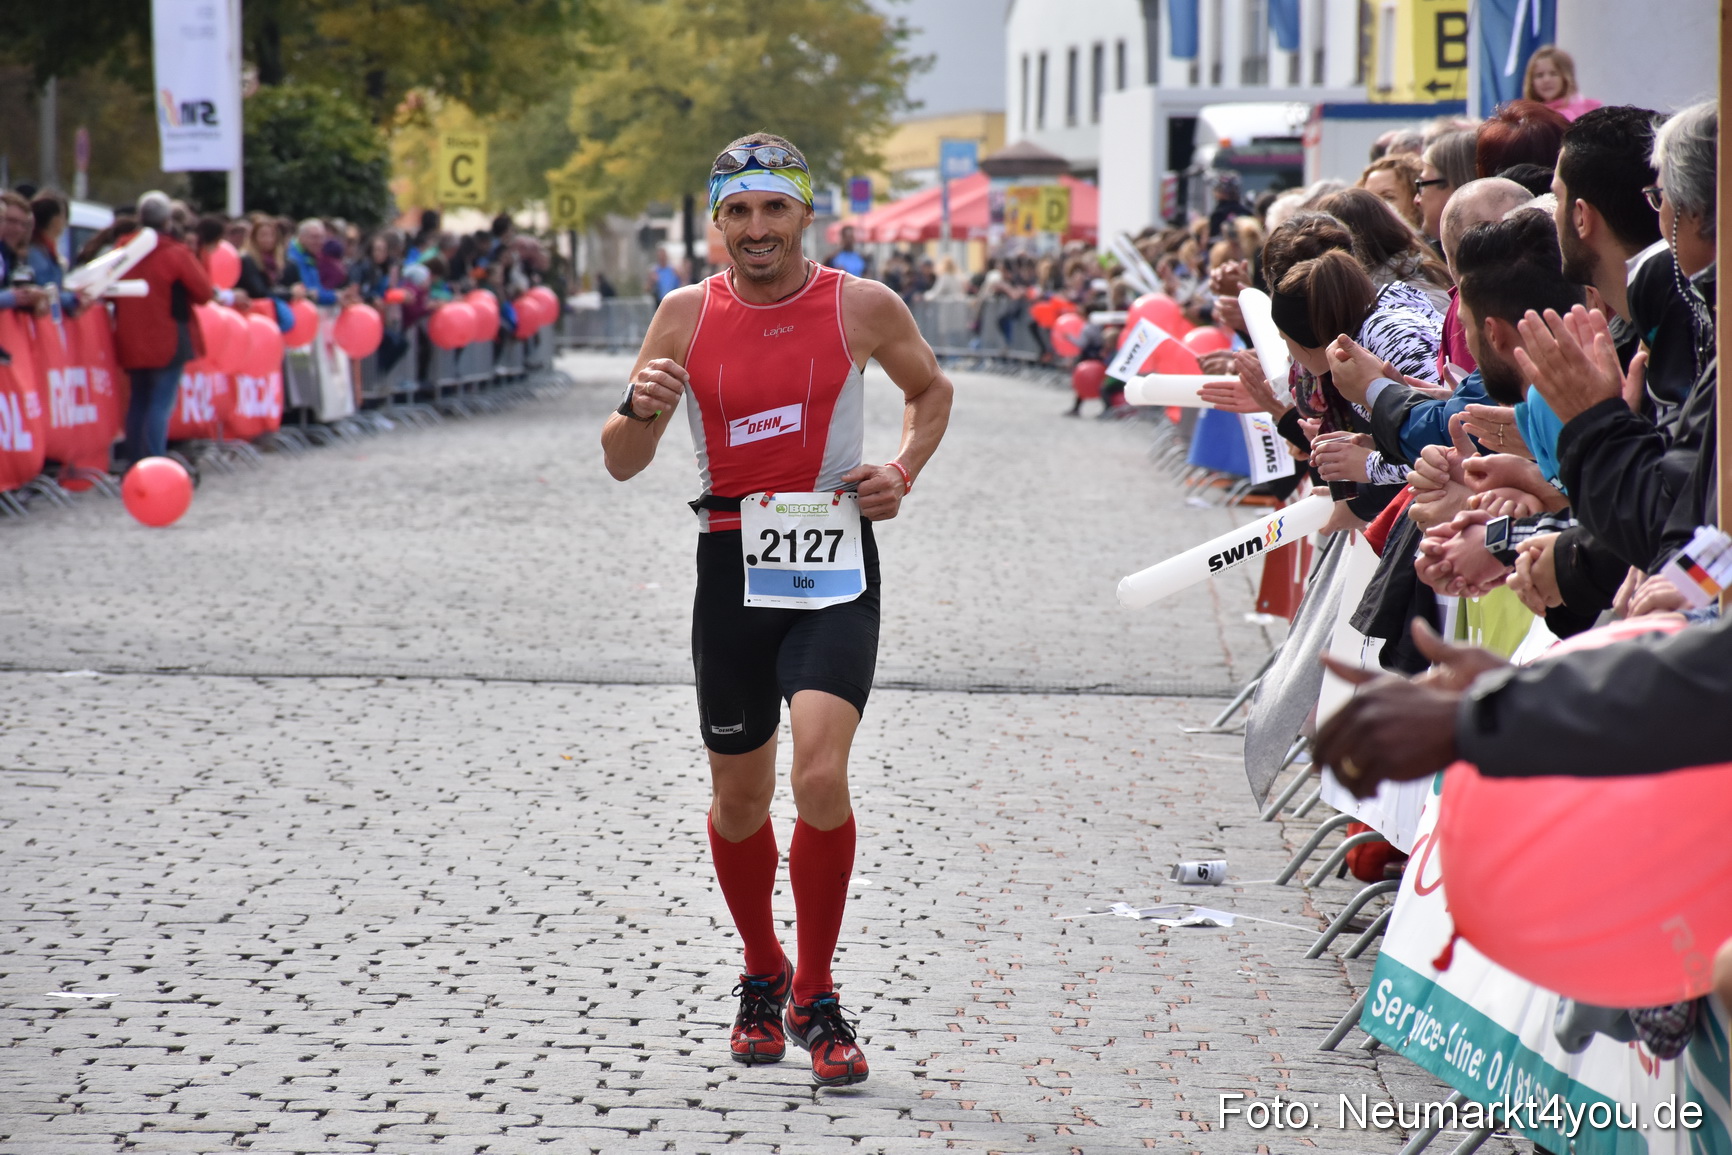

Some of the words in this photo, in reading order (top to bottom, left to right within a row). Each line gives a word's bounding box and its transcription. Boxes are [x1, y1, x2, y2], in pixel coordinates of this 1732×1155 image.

[1436, 11, 1468, 70] B
[450, 153, 474, 187] C
[558, 194, 577, 218] D
[1046, 200, 1064, 223] D
[763, 324, 795, 338] Lance
[1118, 342, 1142, 374] swn
[747, 415, 782, 435] DEHN
[1261, 434, 1278, 474] swn
[788, 504, 829, 514] BOCK
[760, 528, 844, 563] 2127
[1208, 536, 1263, 573] swn
[793, 576, 815, 589] Udo
[1371, 978, 1486, 1082] Service-Line:
[1486, 1051, 1503, 1091] 0
